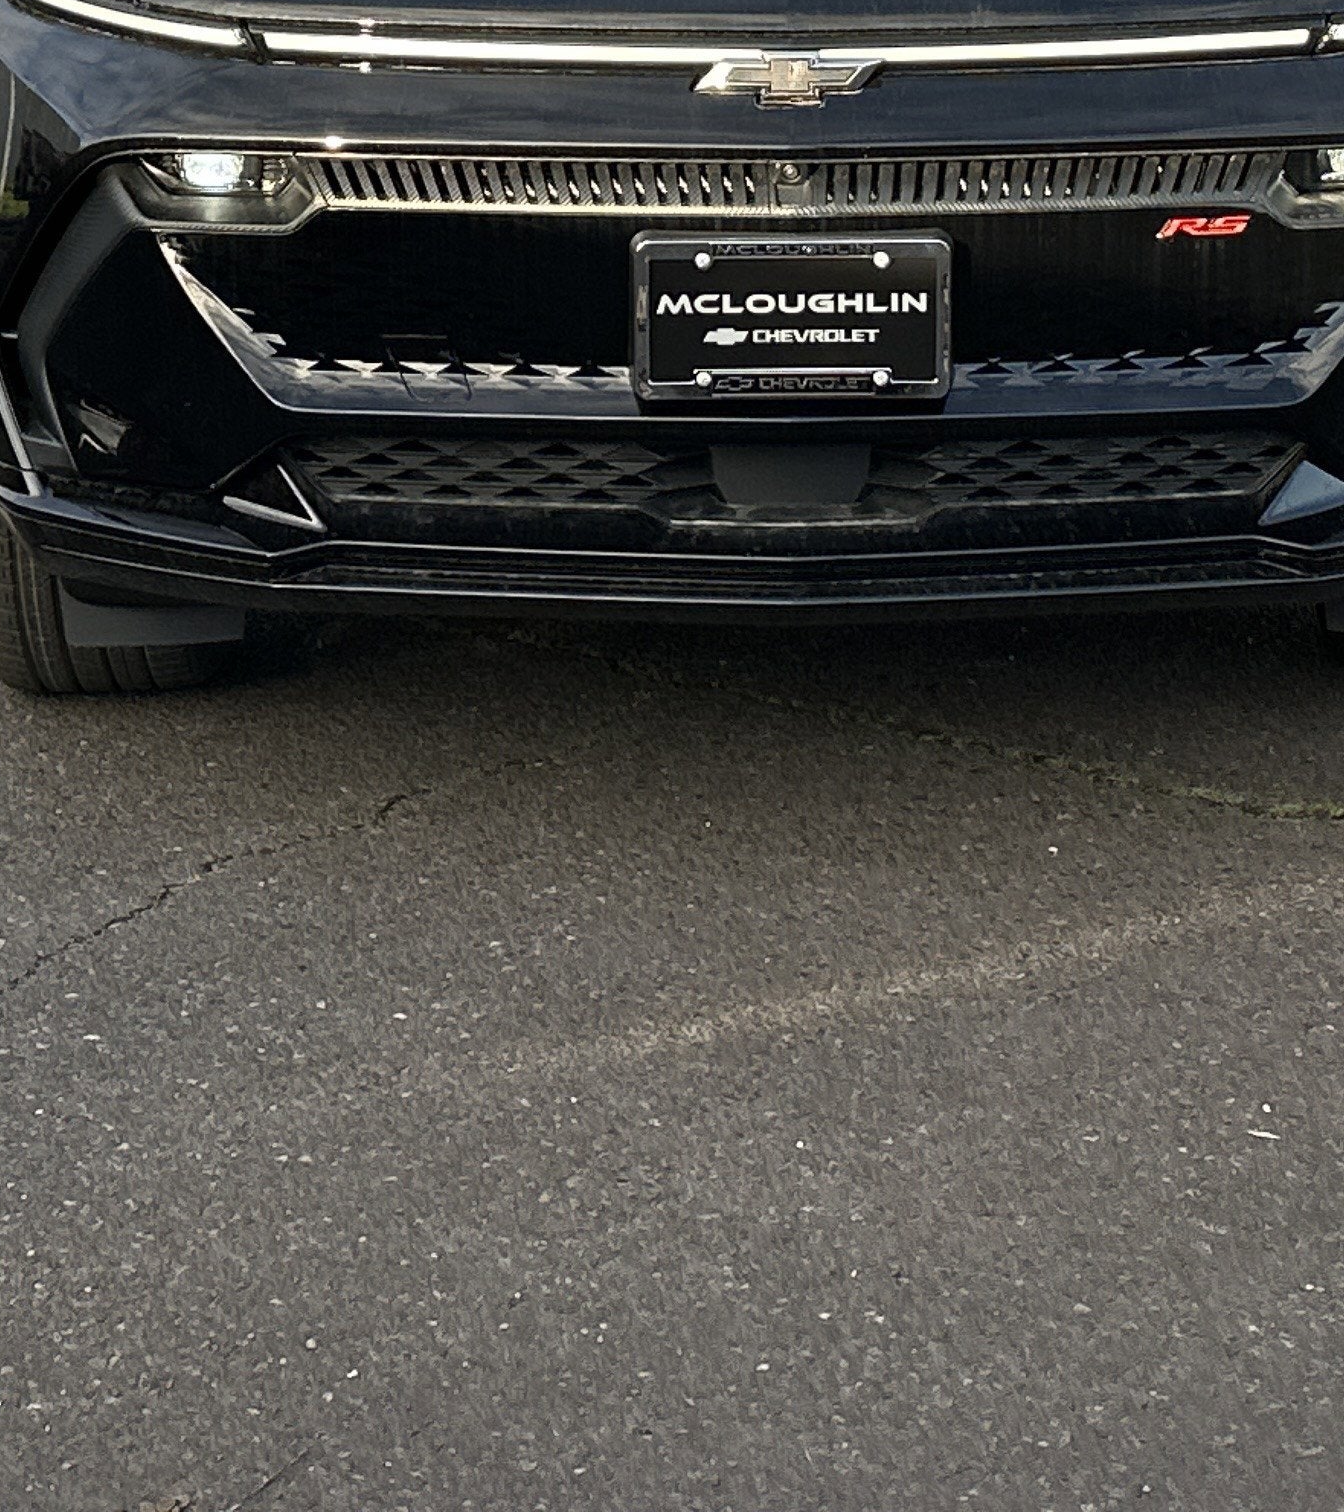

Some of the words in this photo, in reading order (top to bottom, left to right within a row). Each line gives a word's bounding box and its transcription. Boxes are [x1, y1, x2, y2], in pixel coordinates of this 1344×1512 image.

[1155, 214, 1252, 239] RS
[656, 292, 928, 315] MCLOUGHLIN
[752, 328, 880, 343] CHEVROLET
